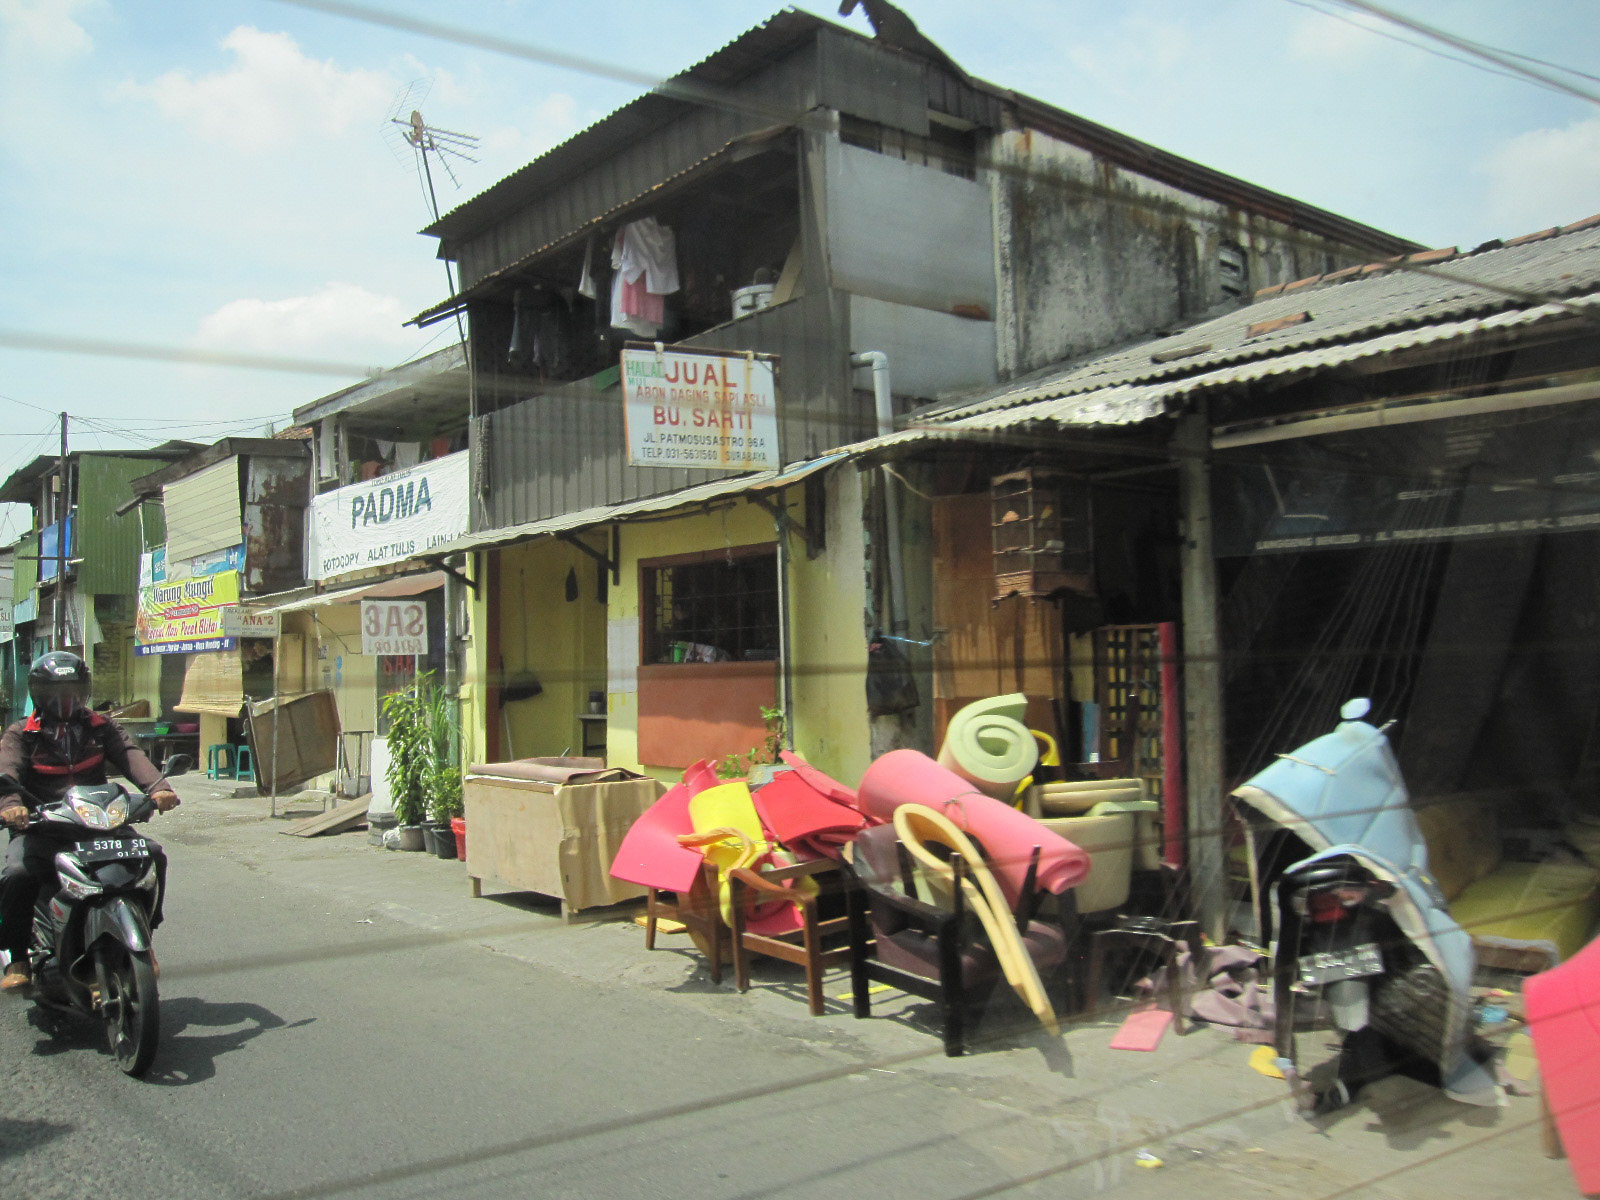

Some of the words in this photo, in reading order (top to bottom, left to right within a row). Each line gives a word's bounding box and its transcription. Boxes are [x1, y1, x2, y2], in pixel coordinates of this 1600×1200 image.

[665, 361, 737, 387] JUAL
[636, 386, 665, 400] ABON
[671, 388, 710, 403] DAGING
[693, 408, 752, 430] SARTI
[352, 477, 431, 529] PADMA
[368, 546, 388, 561] ALAT
[391, 541, 414, 557] TULIS
[153, 586, 182, 604] Warung
[76, 842, 84, 851] L
[94, 840, 122, 850] 5378
